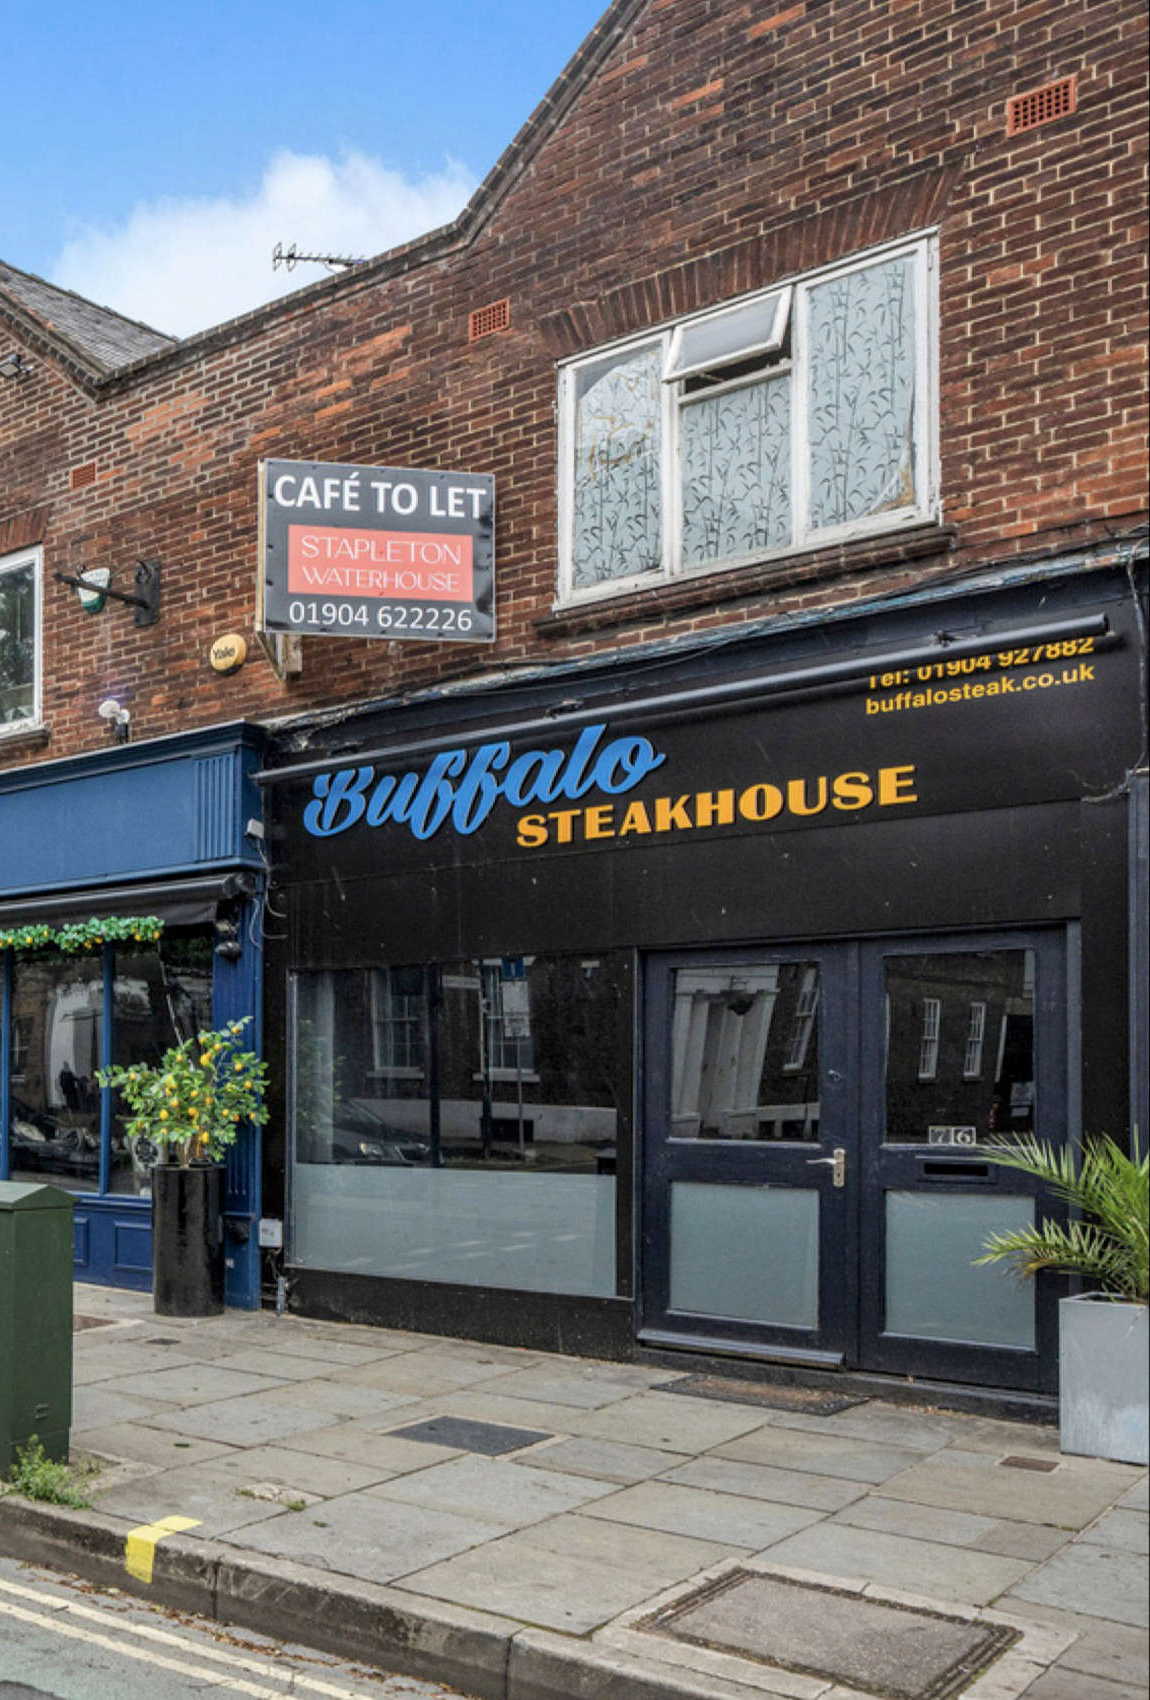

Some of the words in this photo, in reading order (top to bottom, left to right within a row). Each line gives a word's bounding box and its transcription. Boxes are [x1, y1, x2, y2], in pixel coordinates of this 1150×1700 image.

[274, 472, 361, 512] CAFÉ
[371, 481, 419, 516] TO
[430, 486, 487, 519] LET
[301, 535, 461, 566] STAPLETON
[302, 567, 460, 592] WATERHOUSE
[289, 601, 369, 626] 01904
[377, 605, 472, 631] 622226
[865, 663, 1096, 715] buffalosteak.co.uk
[304, 724, 666, 840] Buffalo
[516, 765, 918, 848] STEAKHOUSE
